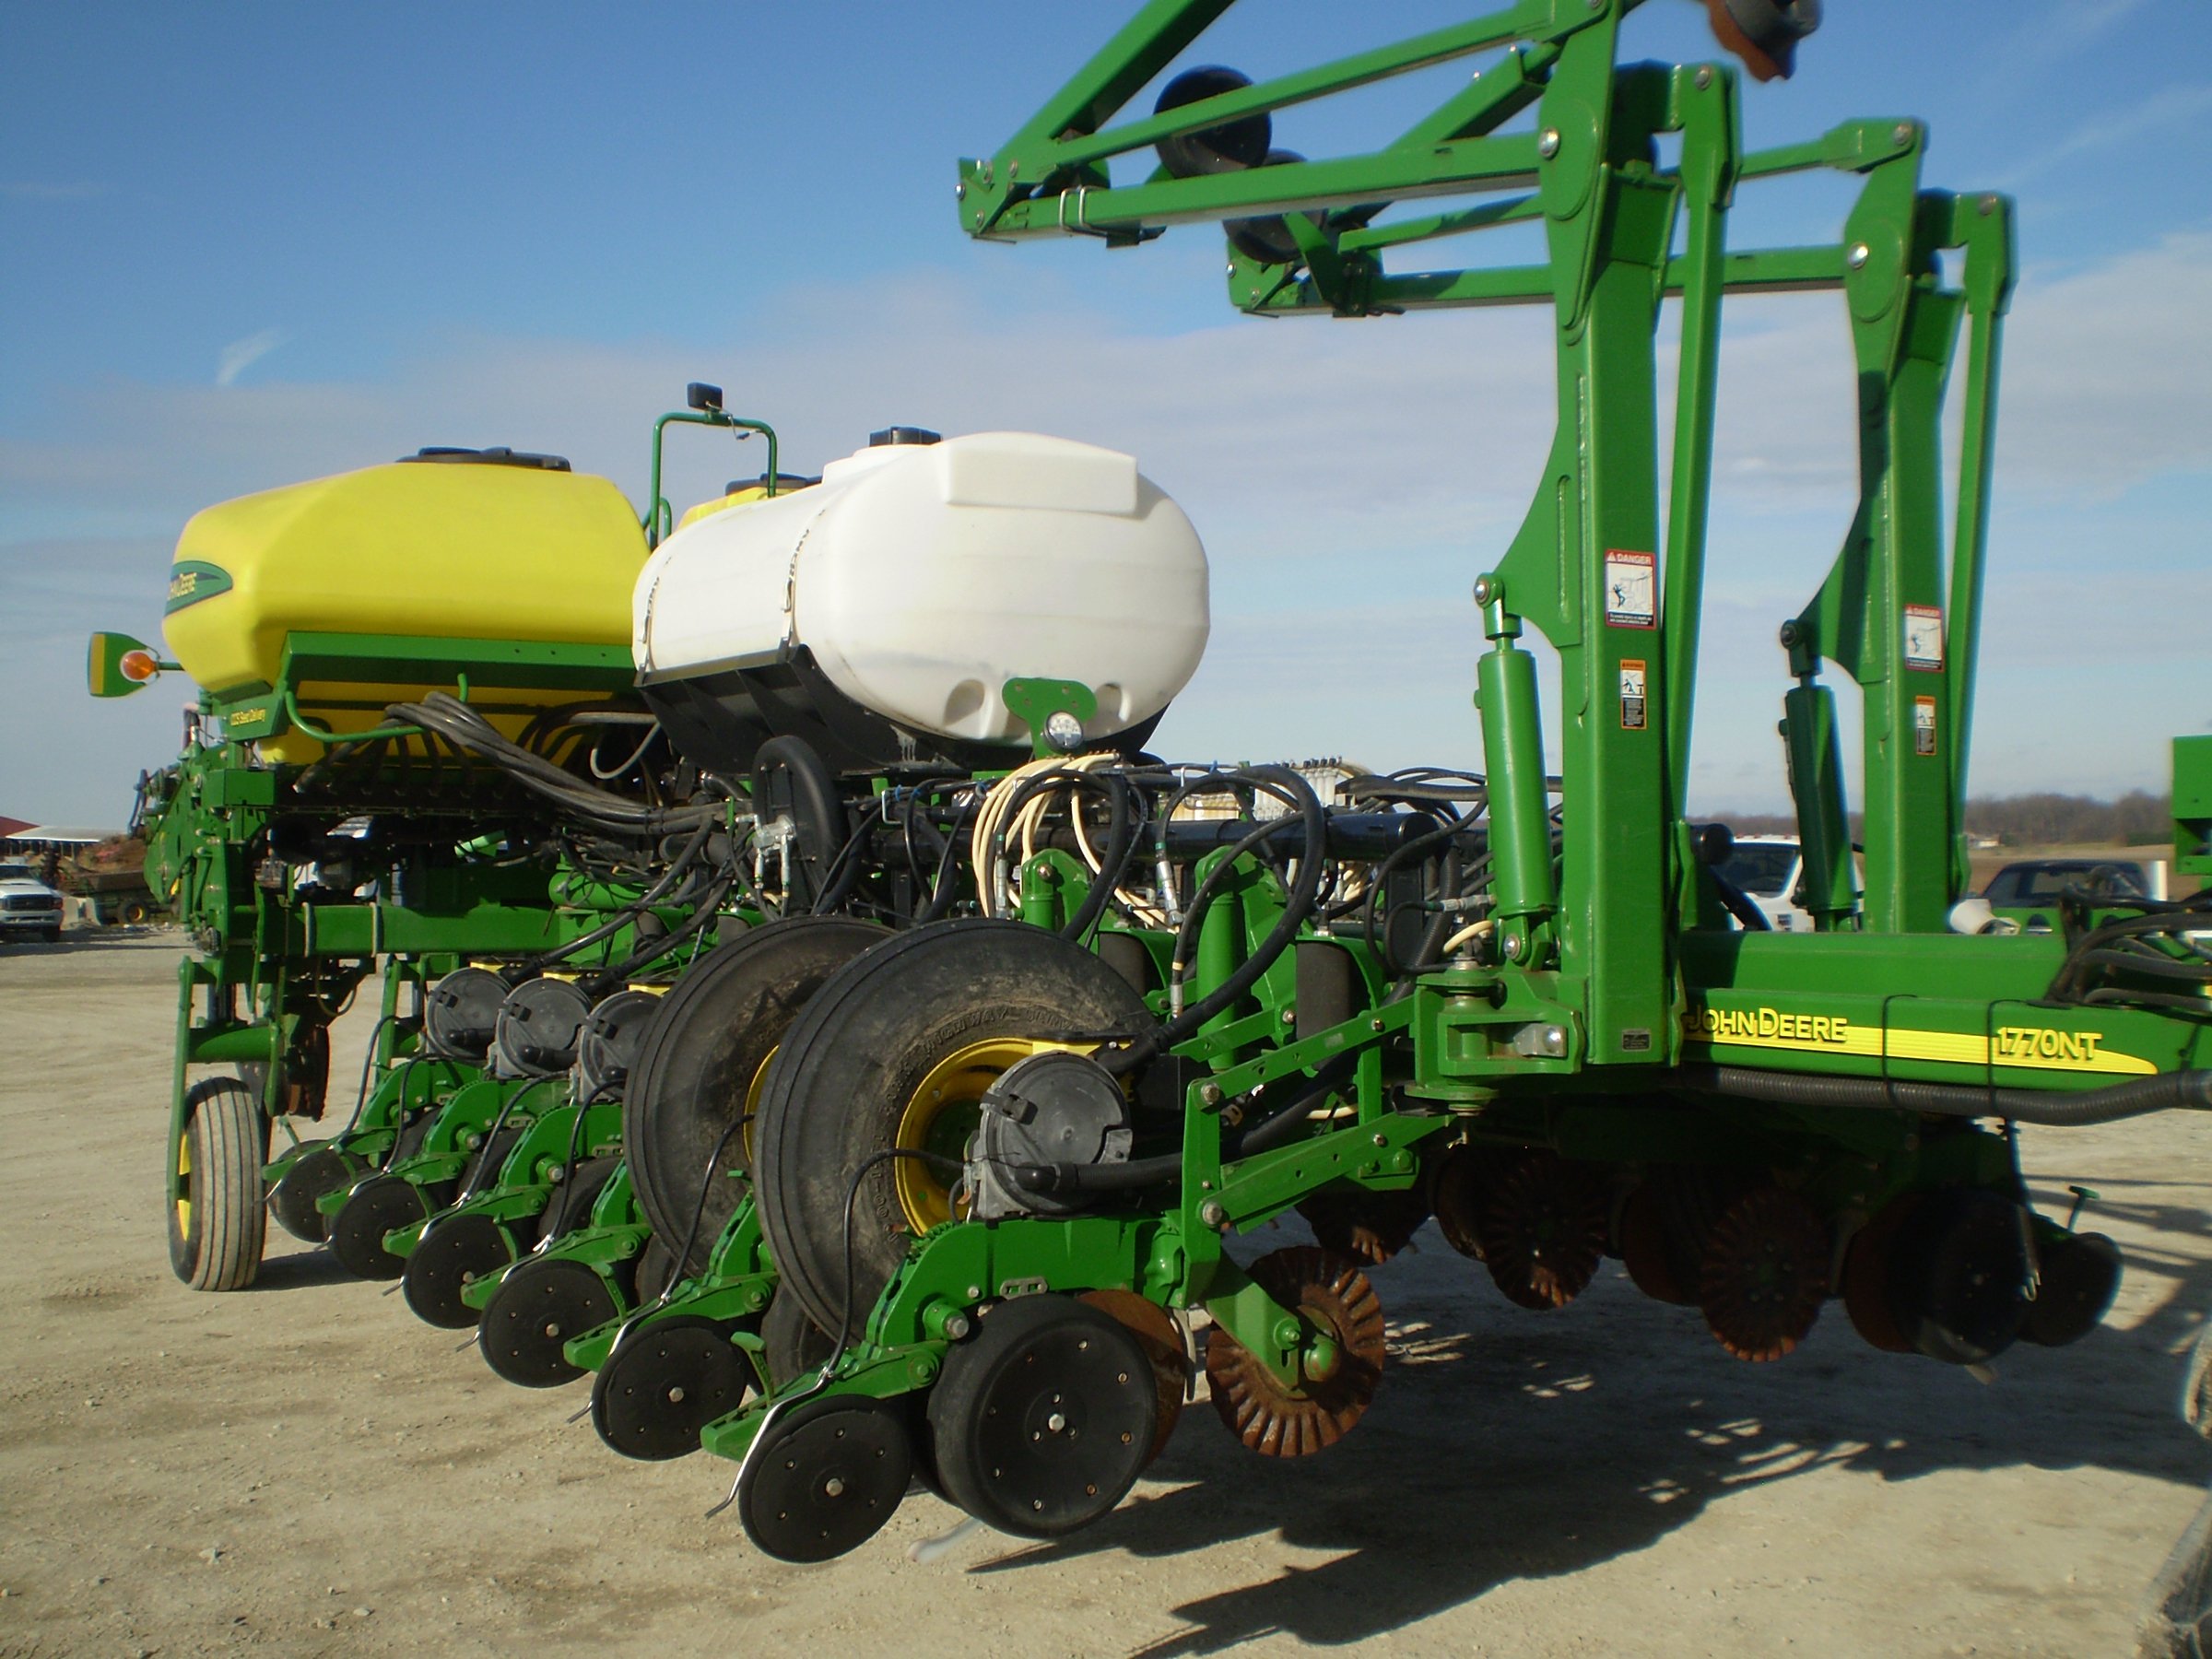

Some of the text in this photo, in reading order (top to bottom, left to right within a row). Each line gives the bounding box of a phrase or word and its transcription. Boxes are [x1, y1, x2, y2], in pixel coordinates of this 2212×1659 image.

[1617, 554, 1652, 564] DANGER
[1688, 1005, 1848, 1041] JOHN DEERE
[1998, 1027, 2102, 1059] 1770NT
